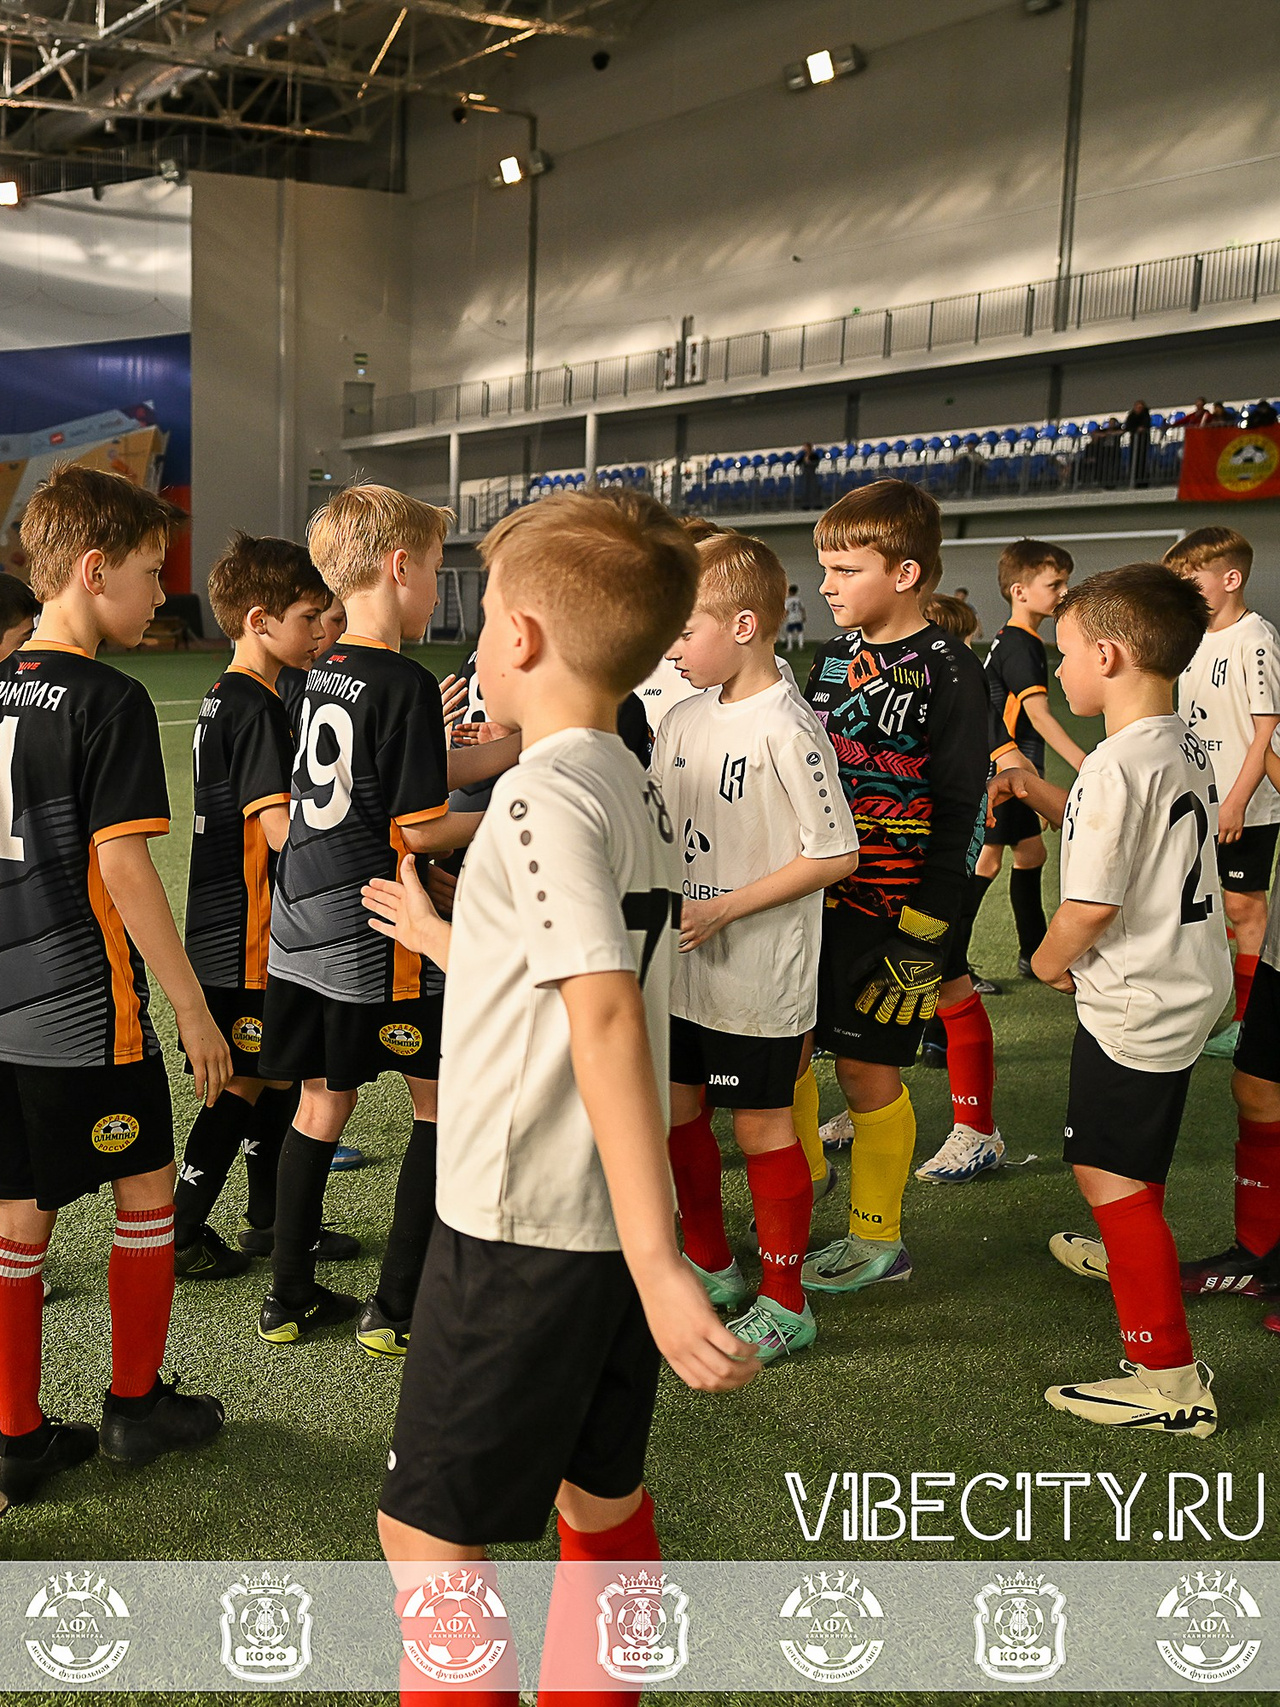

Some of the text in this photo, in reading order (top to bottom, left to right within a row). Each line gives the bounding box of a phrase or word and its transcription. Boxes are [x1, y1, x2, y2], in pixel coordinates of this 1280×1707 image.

[709, 1074, 740, 1086] JAKO
[951, 1093, 978, 1106] AKO
[94, 1132, 136, 1143] ОЛИМПИЯ
[1120, 1329, 1153, 1343] AKO
